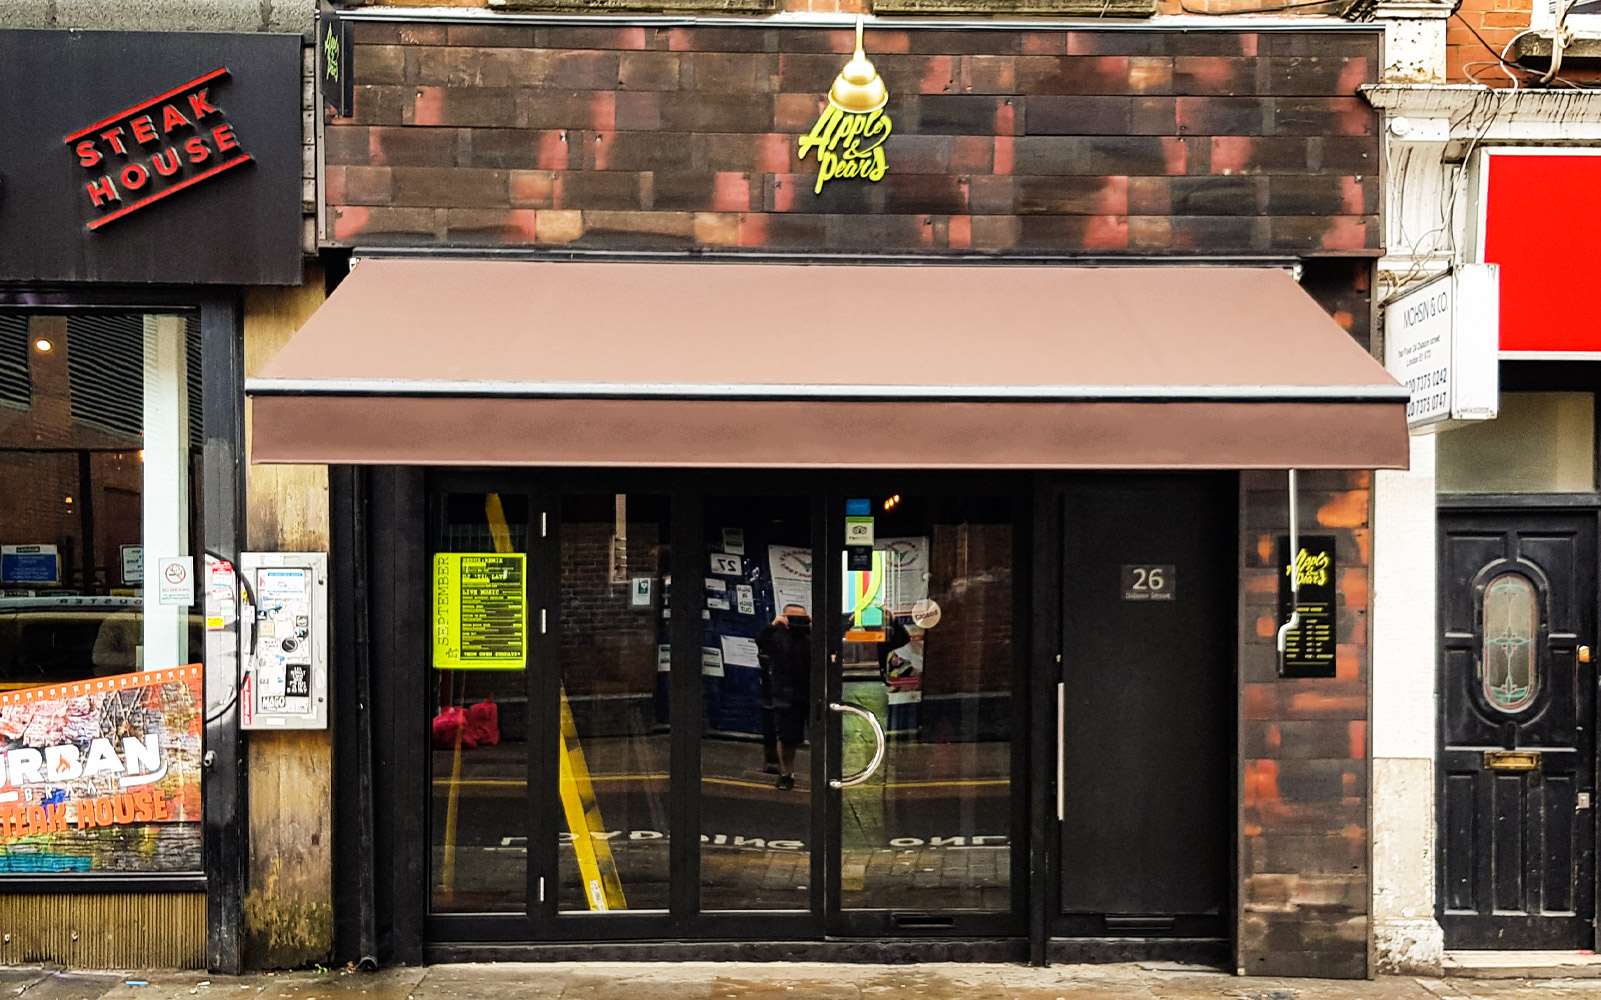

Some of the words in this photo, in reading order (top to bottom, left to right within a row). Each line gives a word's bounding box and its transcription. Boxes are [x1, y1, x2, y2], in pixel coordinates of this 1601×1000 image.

[76, 88, 217, 167] STEAK
[798, 104, 891, 162] Apple
[87, 124, 238, 207] HOUSE
[843, 139, 873, 160] &
[814, 146, 889, 194] Pears
[1403, 300, 1429, 330] MOHSIN
[1430, 297, 1436, 317] &
[1417, 373, 1430, 391] 7375
[1432, 368, 1447, 386] 0242
[1416, 397, 1430, 416] 7375
[1432, 391, 1446, 411] 0747
[1132, 568, 1165, 590] 26
[437, 556, 449, 646] SEPTEMBER
[77, 790, 169, 830] HOUSE
